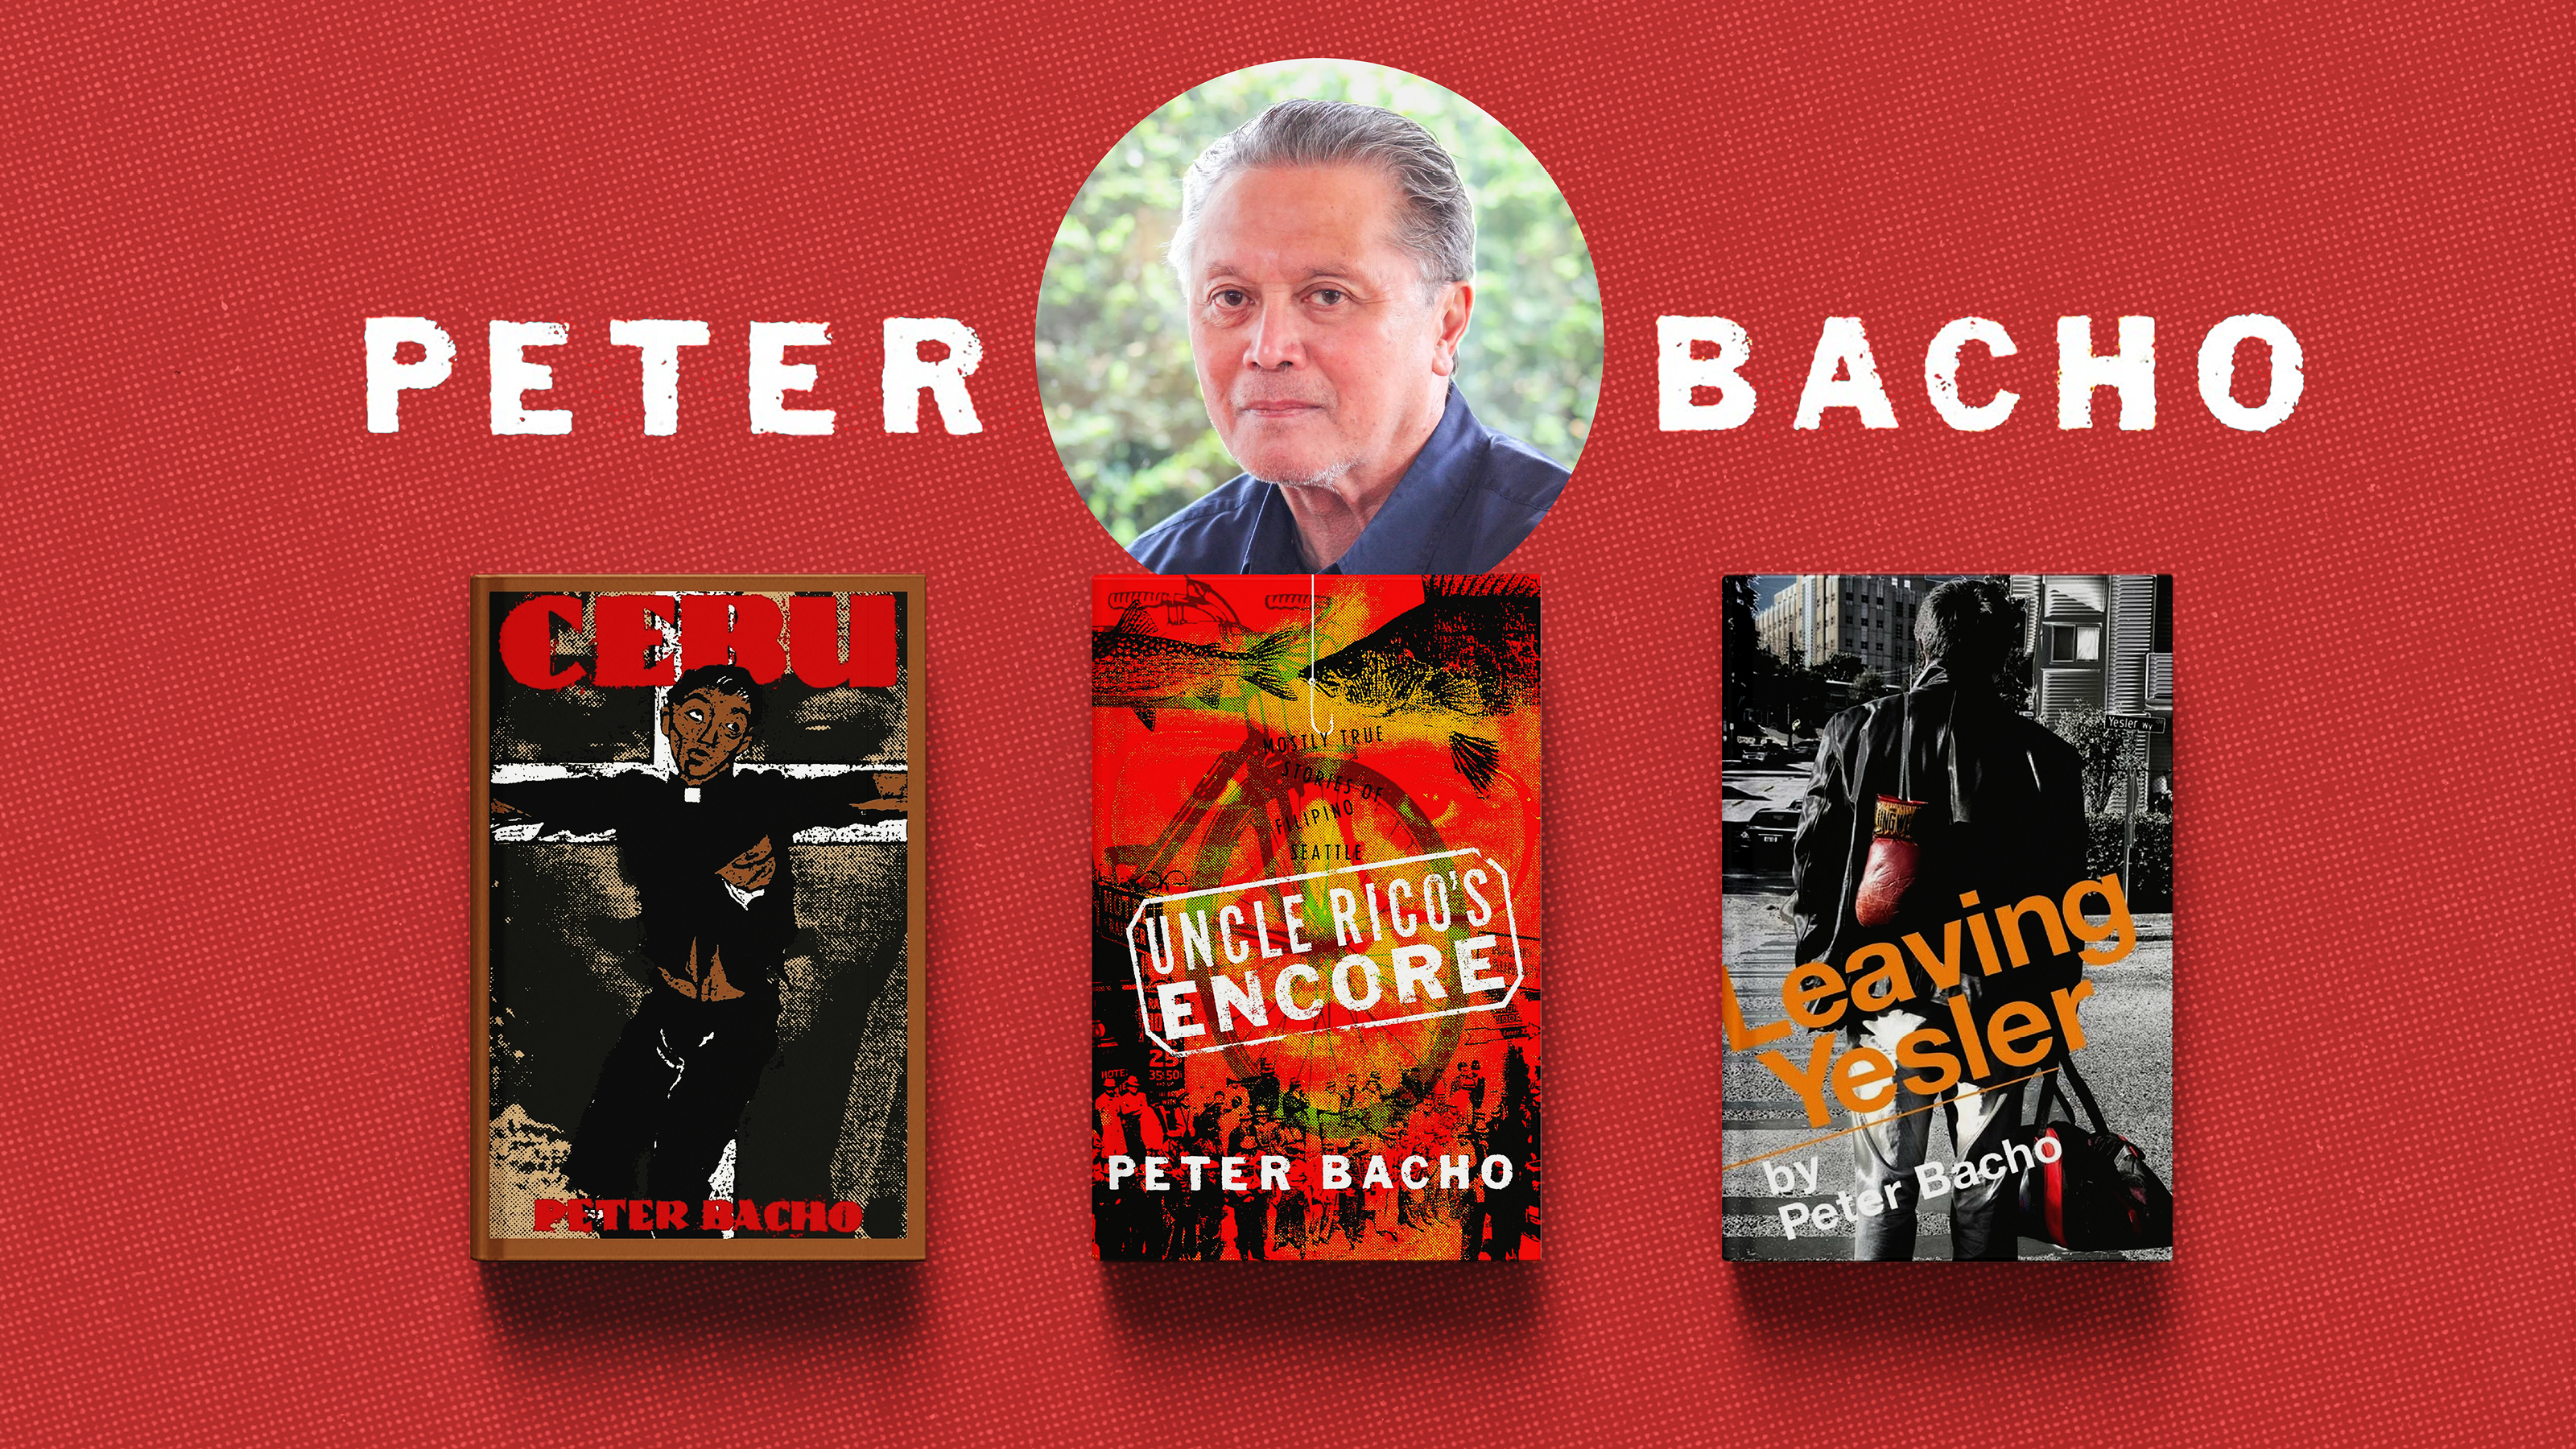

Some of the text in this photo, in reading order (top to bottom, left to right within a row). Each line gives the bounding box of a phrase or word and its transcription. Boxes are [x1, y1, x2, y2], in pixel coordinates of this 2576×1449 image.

[499, 594, 898, 690] CEBU
[1263, 725, 1383, 755] MOSTLY TRUE
[2108, 716, 2138, 729] Yesler
[1282, 761, 1383, 803] STORIES OF
[1275, 799, 1353, 835] FILIPINO
[1291, 844, 1361, 861] SEATTLE
[1146, 869, 1492, 975] UNCLE RICO'S
[1722, 873, 2137, 1051] Leaving
[1156, 935, 1505, 1040] ENCORE
[1757, 979, 2095, 1129] Yesler
[1109, 1154, 1513, 1191] PETER BACHO
[1763, 1156, 1819, 1195] by
[1778, 1137, 2062, 1241] Peter Bacho
[534, 1198, 863, 1233] PETER BACHO
